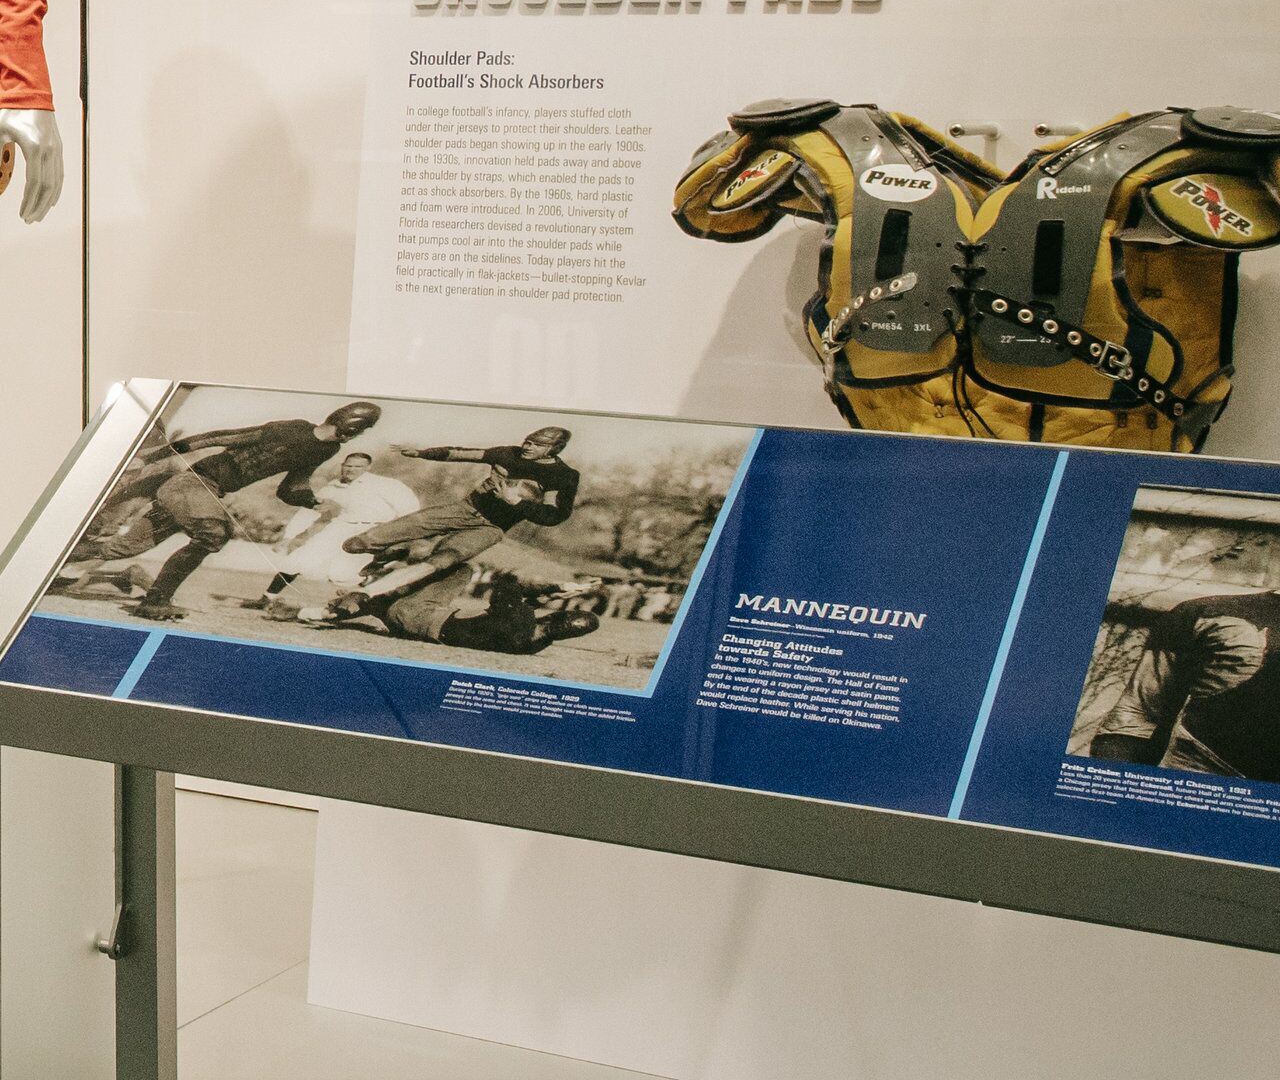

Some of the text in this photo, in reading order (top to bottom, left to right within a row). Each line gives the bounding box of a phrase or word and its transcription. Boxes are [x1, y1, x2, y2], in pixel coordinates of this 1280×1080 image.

[409, 51, 515, 65] Shoulder Pads:
[479, 74, 525, 88] Shock
[528, 74, 604, 89] Absorbers
[406, 107, 414, 116] In
[416, 107, 449, 118] college
[533, 108, 567, 119] players
[569, 108, 605, 118] stuffed
[606, 109, 631, 118] cloth
[405, 123, 431, 132] under
[433, 123, 454, 132] their
[456, 123, 489, 135] jerseys
[490, 124, 500, 133] to
[502, 124, 537, 135] protect
[538, 124, 560, 134] their
[614, 125, 652, 135] Leather
[404, 139, 442, 148] shoulder
[444, 139, 467, 151] pads
[469, 140, 498, 151] began
[500, 140, 540, 152] showing
[542, 143, 555, 152] up
[557, 141, 567, 150] in
[569, 141, 585, 150] the
[587, 141, 614, 153] early
[403, 154, 412, 163] In
[414, 154, 431, 164] the
[463, 155, 512, 165] innovation
[513, 156, 535, 166] held
[536, 157, 560, 168] pads
[562, 160, 589, 169] away
[590, 158, 609, 167] and
[611, 158, 641, 168] above
[402, 170, 416, 180] the
[418, 171, 458, 181] shoulder
[460, 172, 471, 183] by
[506, 173, 536, 182] which
[538, 173, 576, 183] enabled
[578, 174, 596, 183] the
[597, 174, 622, 186] pads
[624, 175, 635, 184] to
[401, 186, 415, 196] act
[430, 187, 457, 197] shock
[509, 189, 522, 200] By
[524, 189, 542, 199] the
[576, 190, 598, 200] hard
[600, 191, 633, 203] plastic
[735, 594, 927, 629] MANNEQUIN
[722, 635, 844, 656] Changing Attitudes
[718, 645, 814, 664] towards Safety
[723, 655, 739, 663] the
[792, 664, 840, 676] technology
[841, 669, 870, 678] would
[870, 673, 897, 682] result
[711, 664, 746, 675] changes
[757, 669, 791, 679] uniform
[824, 677, 842, 685] The
[874, 683, 901, 692] Fame
